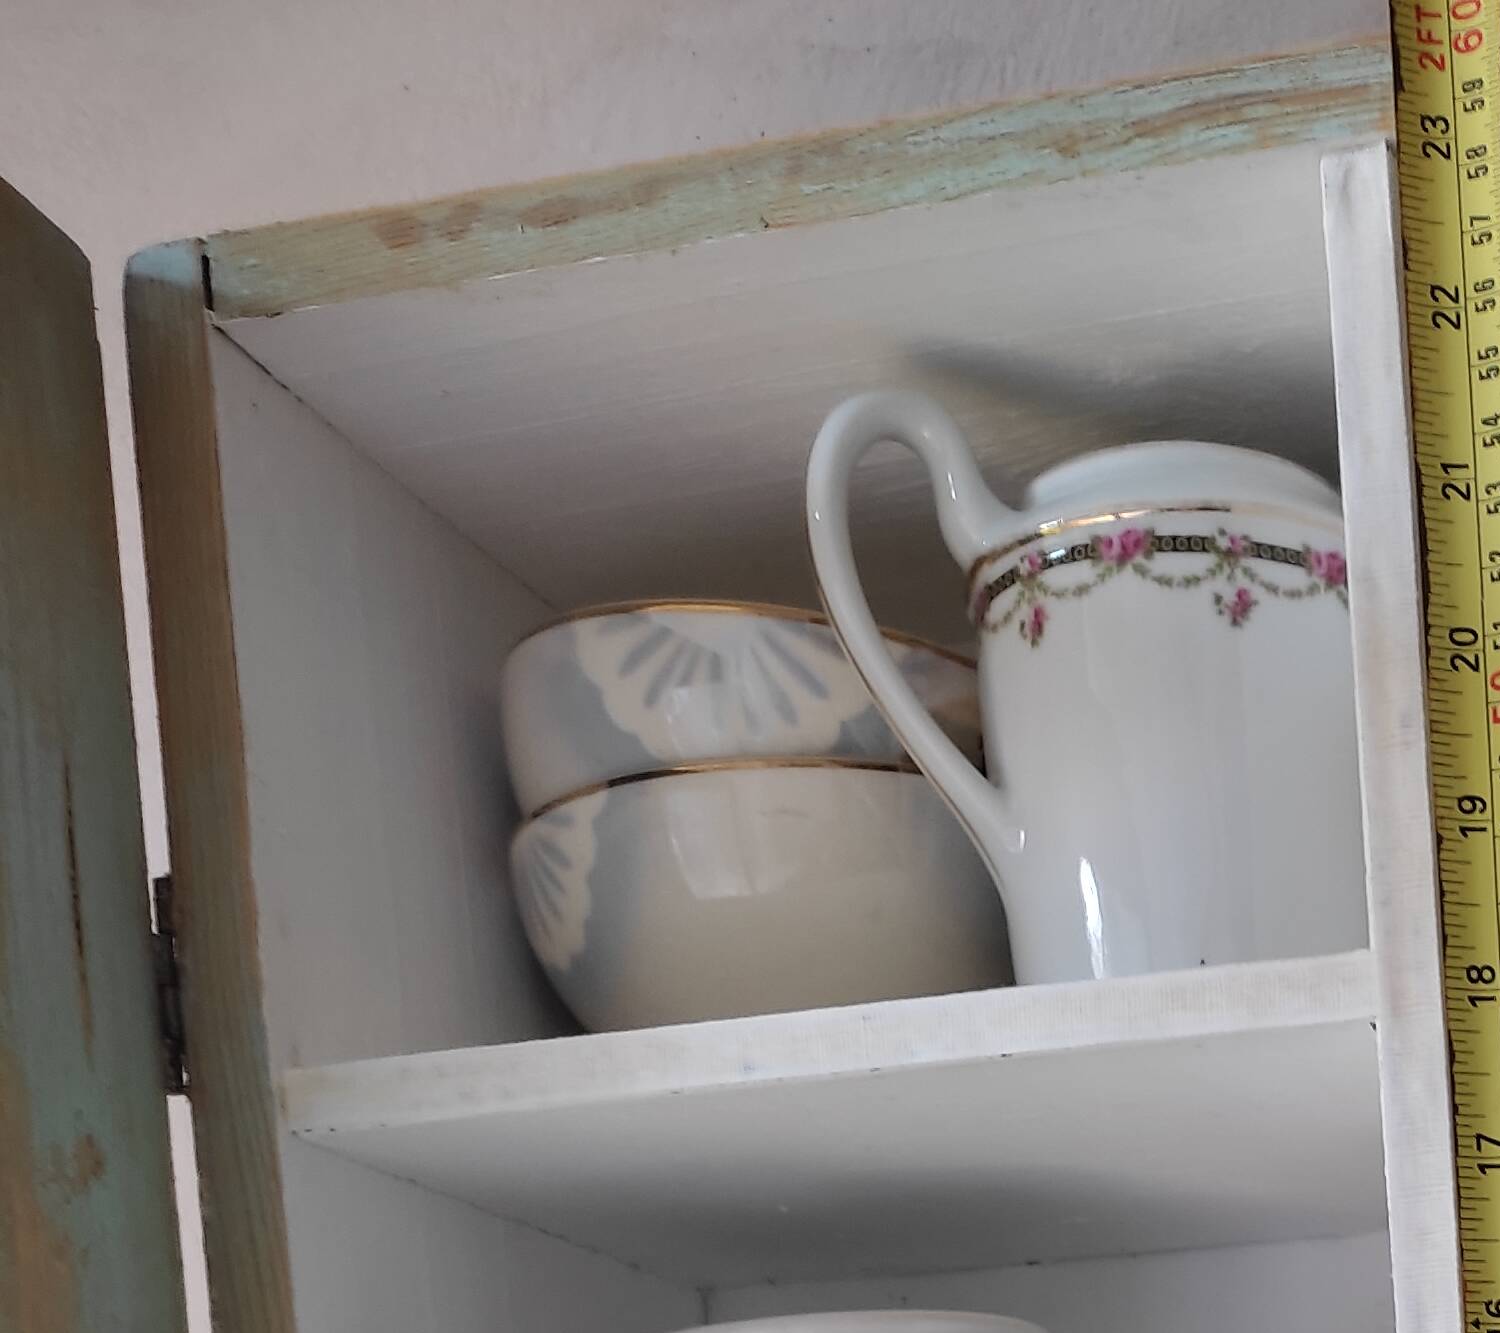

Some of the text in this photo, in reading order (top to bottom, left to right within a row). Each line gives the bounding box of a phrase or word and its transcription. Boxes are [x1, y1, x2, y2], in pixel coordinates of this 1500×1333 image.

[1414, 3, 1446, 72] 2FT
[1451, 0, 1484, 54] 60
[1462, 77, 1485, 112] 59
[1421, 114, 1449, 160] 23
[1466, 144, 1488, 180] 58
[1470, 215, 1492, 246] 57
[1430, 284, 1461, 330] 22
[1474, 278, 1496, 313] 56
[1478, 345, 1500, 381] 55
[1440, 462, 1471, 501] 21
[1448, 626, 1479, 672] 20
[1457, 794, 1487, 839] 19
[1465, 965, 1496, 1009] 18
